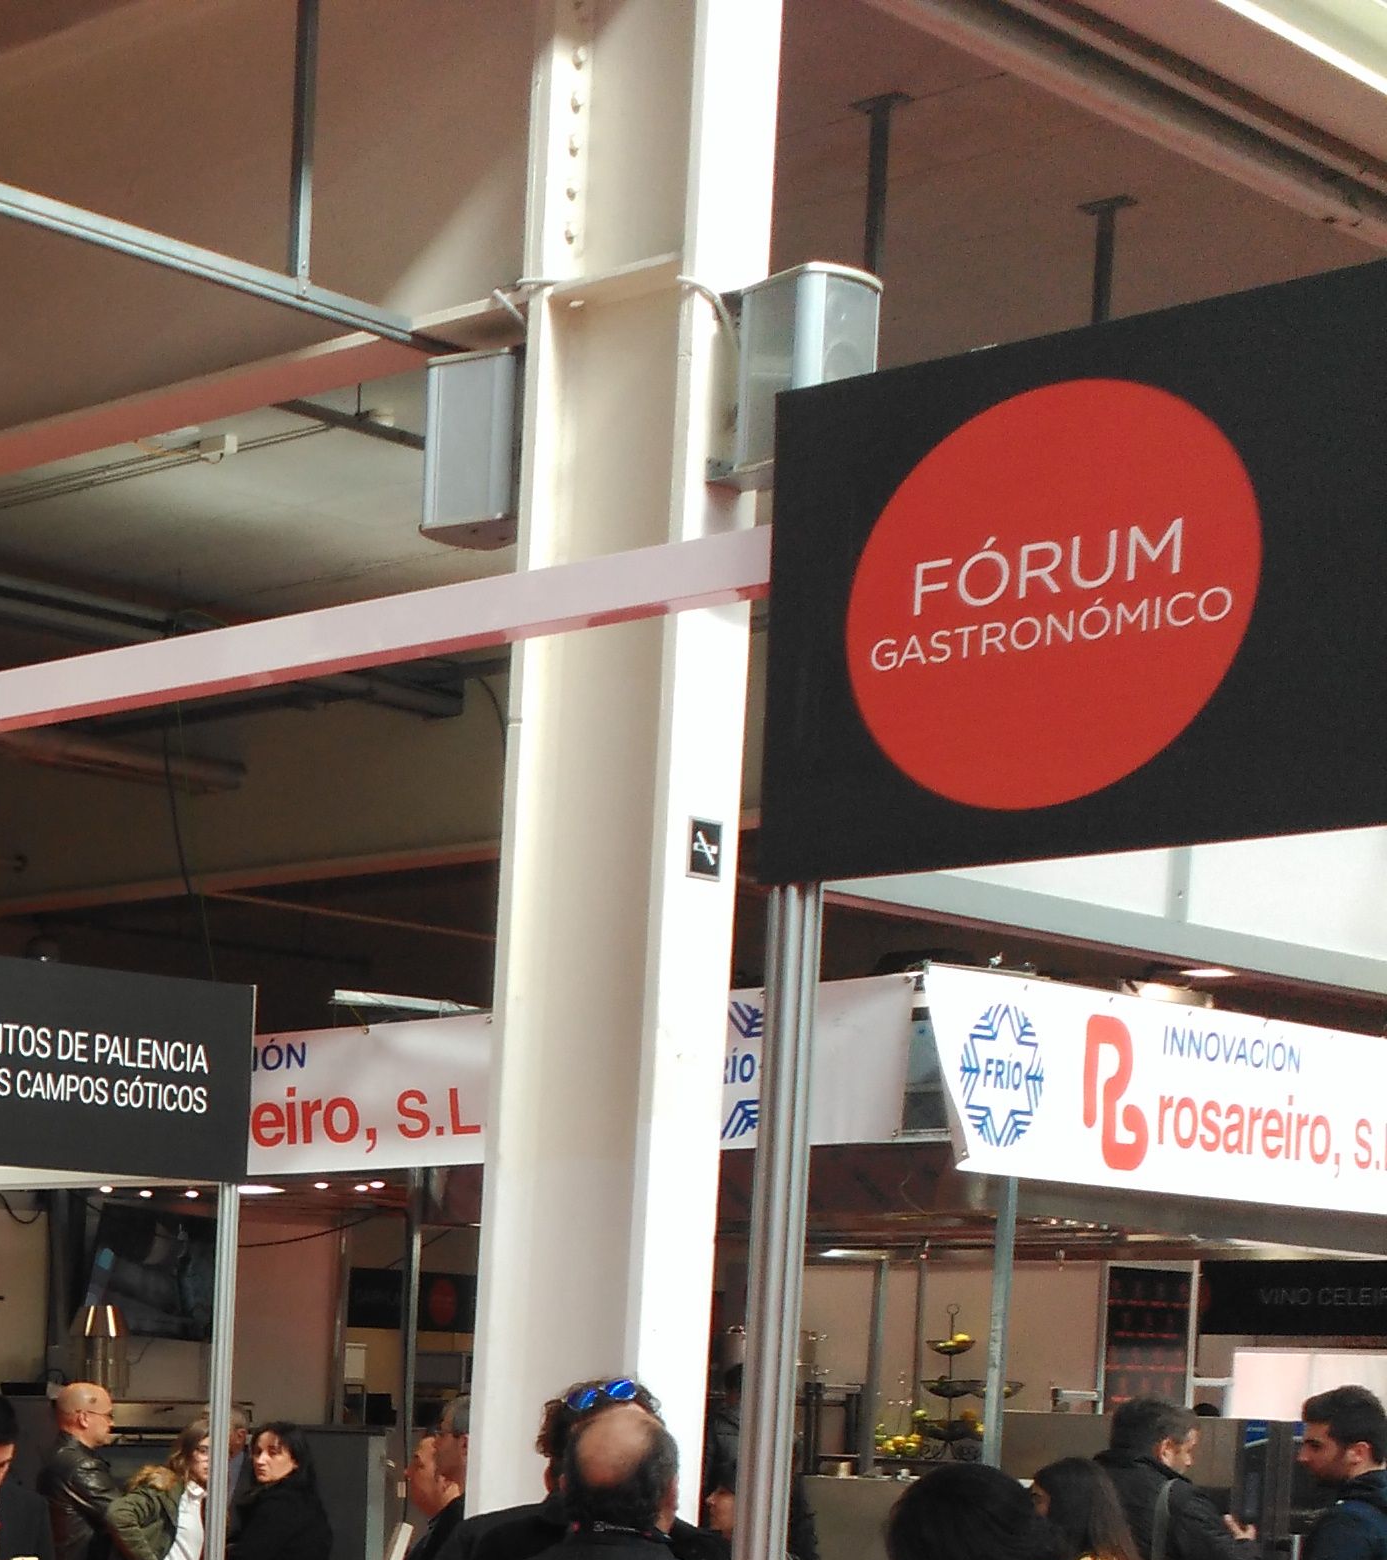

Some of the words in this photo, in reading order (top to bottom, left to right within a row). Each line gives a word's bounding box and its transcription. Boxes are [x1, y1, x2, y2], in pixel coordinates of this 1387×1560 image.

[913, 518, 1185, 616] FÓRUM
[870, 586, 1232, 672] GASTRONÓMICO
[57, 1029, 89, 1063] DE
[94, 1033, 209, 1075] PALENCIA
[983, 1052, 1023, 1091] FRÍO
[1163, 1025, 1301, 1074] INNOVACIÓN
[17, 1070, 111, 1106] CAMPOS
[114, 1068, 208, 1115] GÓTICOS
[1157, 1094, 1341, 1179] rosareiro,
[1354, 1117, 1387, 1172] S.
